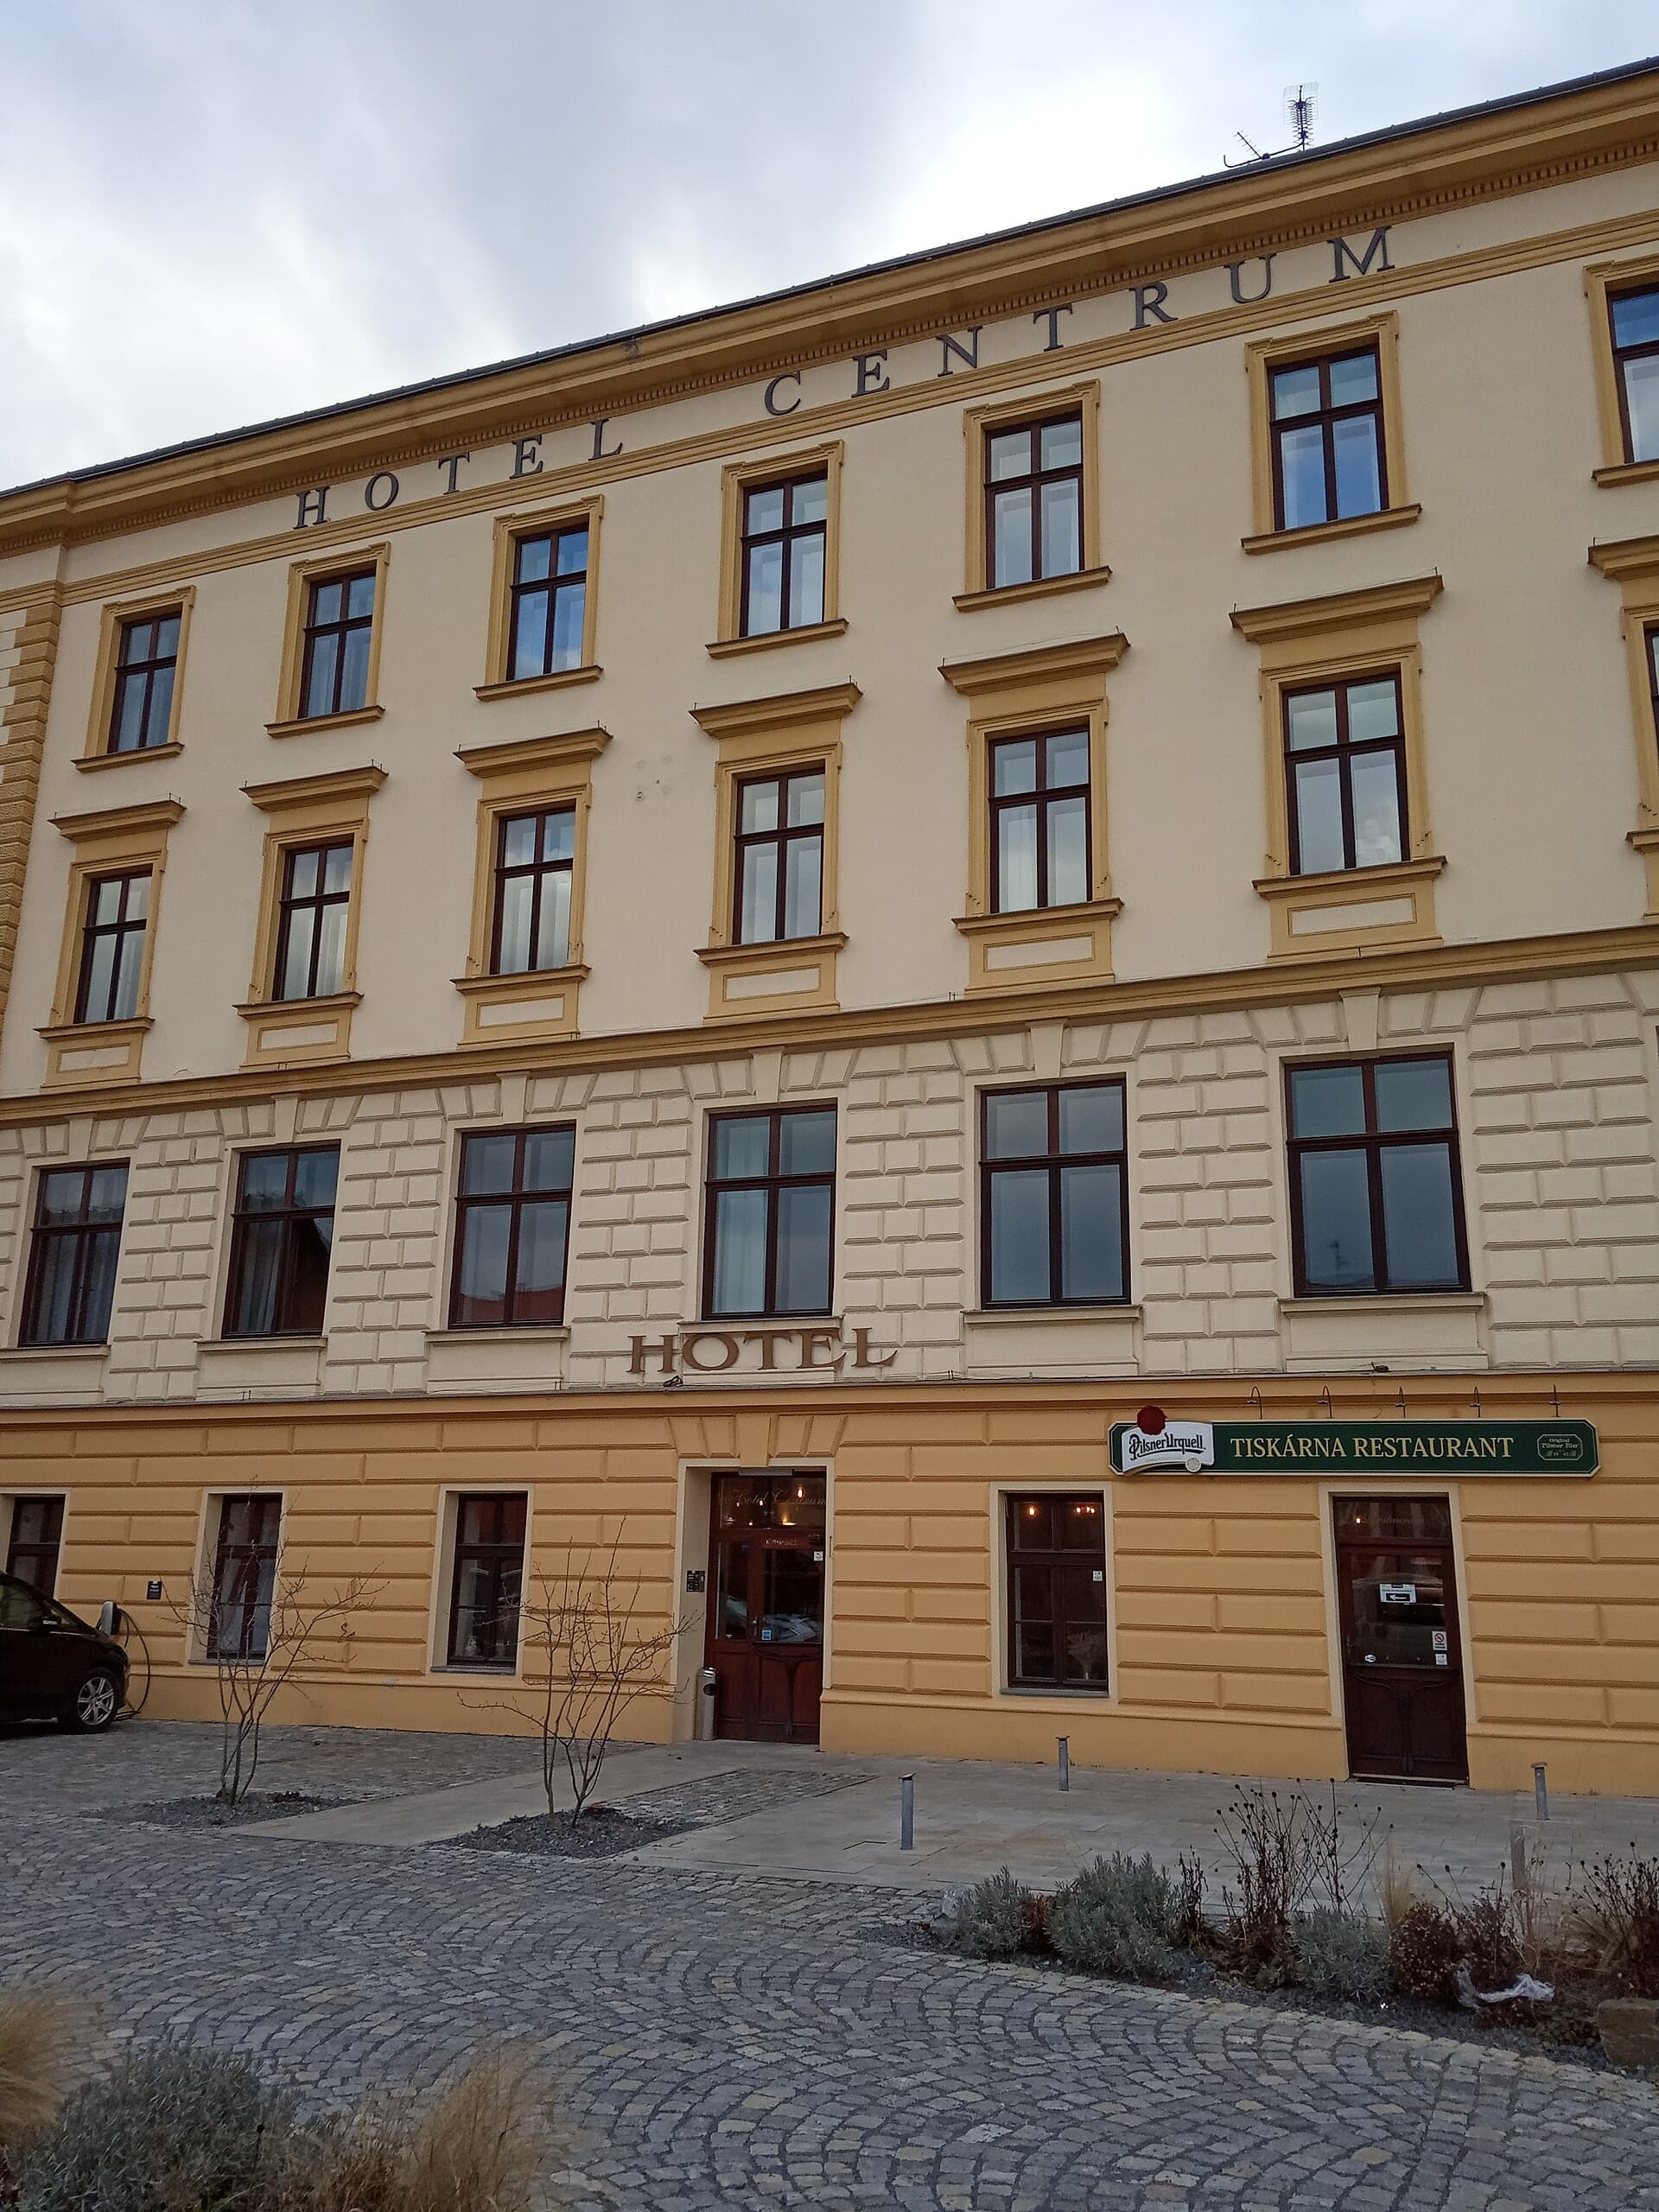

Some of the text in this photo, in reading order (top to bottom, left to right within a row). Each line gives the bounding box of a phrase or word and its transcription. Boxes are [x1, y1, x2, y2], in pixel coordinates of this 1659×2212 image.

[293, 225, 1395, 530] HOTEL CENTRUM
[626, 1326, 899, 1374] HOTEL
[1128, 1432, 1204, 1461] Pilsner Urquell
[1230, 1433, 1515, 1459] TISKÁRNA RESTAURANT
